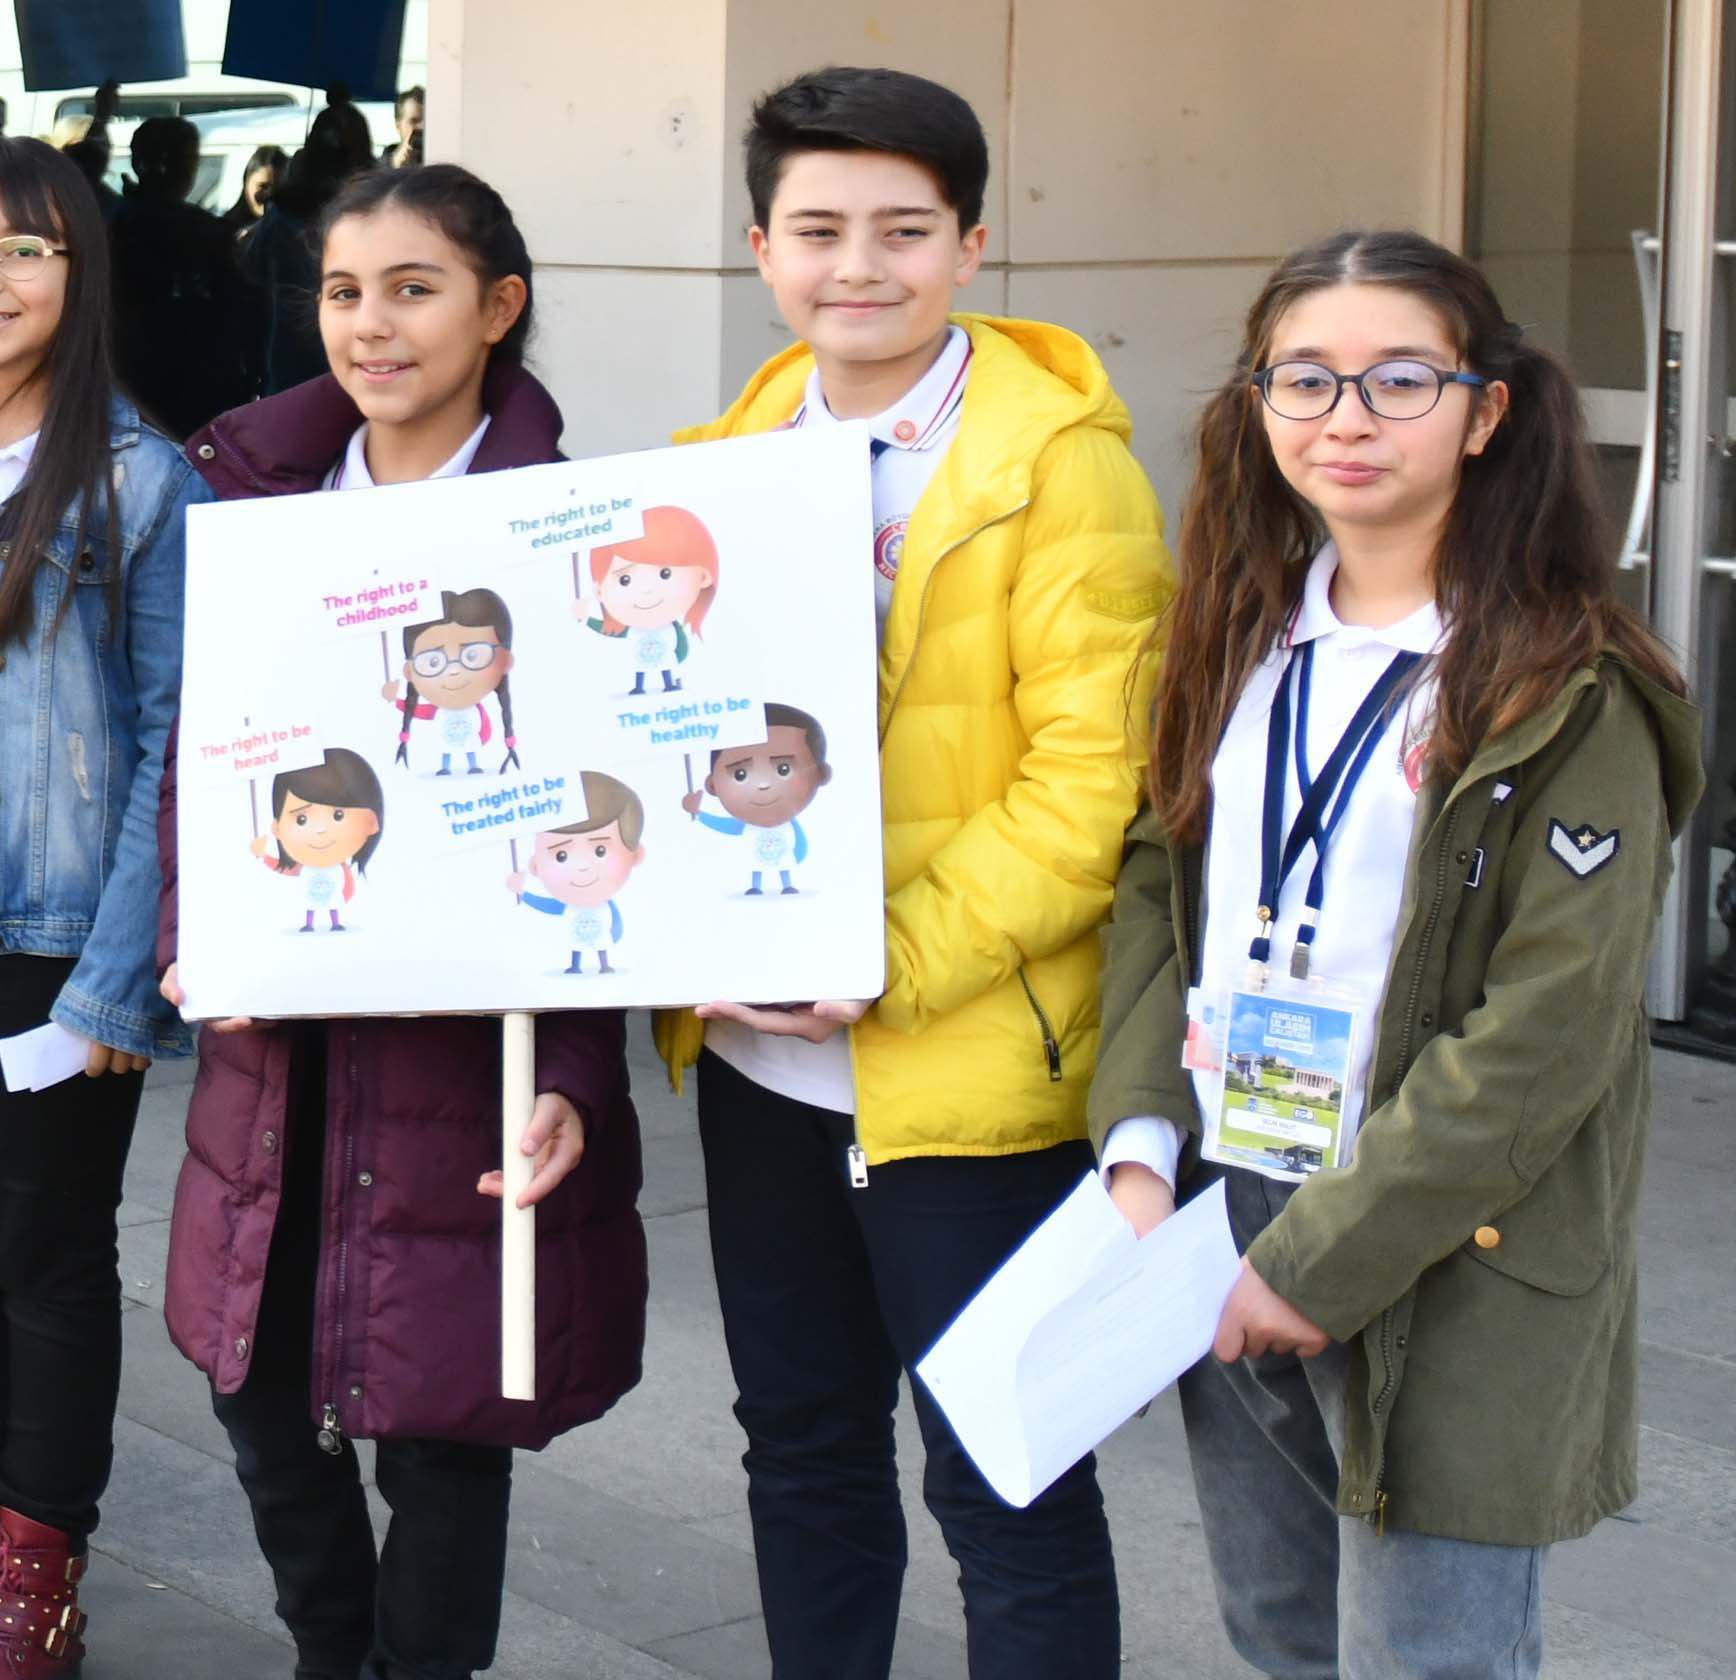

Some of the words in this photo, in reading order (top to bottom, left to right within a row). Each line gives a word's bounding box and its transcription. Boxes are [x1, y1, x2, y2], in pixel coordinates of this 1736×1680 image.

[508, 518, 540, 535] The
[543, 506, 585, 527] right
[589, 502, 608, 517] to
[611, 496, 633, 512] be
[531, 518, 613, 549] educated
[323, 595, 353, 611] The
[356, 583, 395, 604] right
[398, 580, 416, 595] to
[418, 578, 428, 590] a
[336, 598, 419, 627] childhood
[617, 711, 651, 728] The
[655, 703, 699, 724] right
[703, 700, 723, 715] to
[726, 696, 752, 712] be
[199, 744, 229, 760] The
[231, 732, 269, 753] right
[272, 728, 288, 743] to
[291, 723, 312, 738] be
[650, 722, 720, 744] healthy
[233, 750, 279, 771] heard
[442, 801, 474, 818] The
[477, 786, 518, 810] right
[523, 781, 541, 797] to
[544, 775, 565, 791] be
[451, 808, 515, 836] treated
[518, 798, 562, 822] fairly
